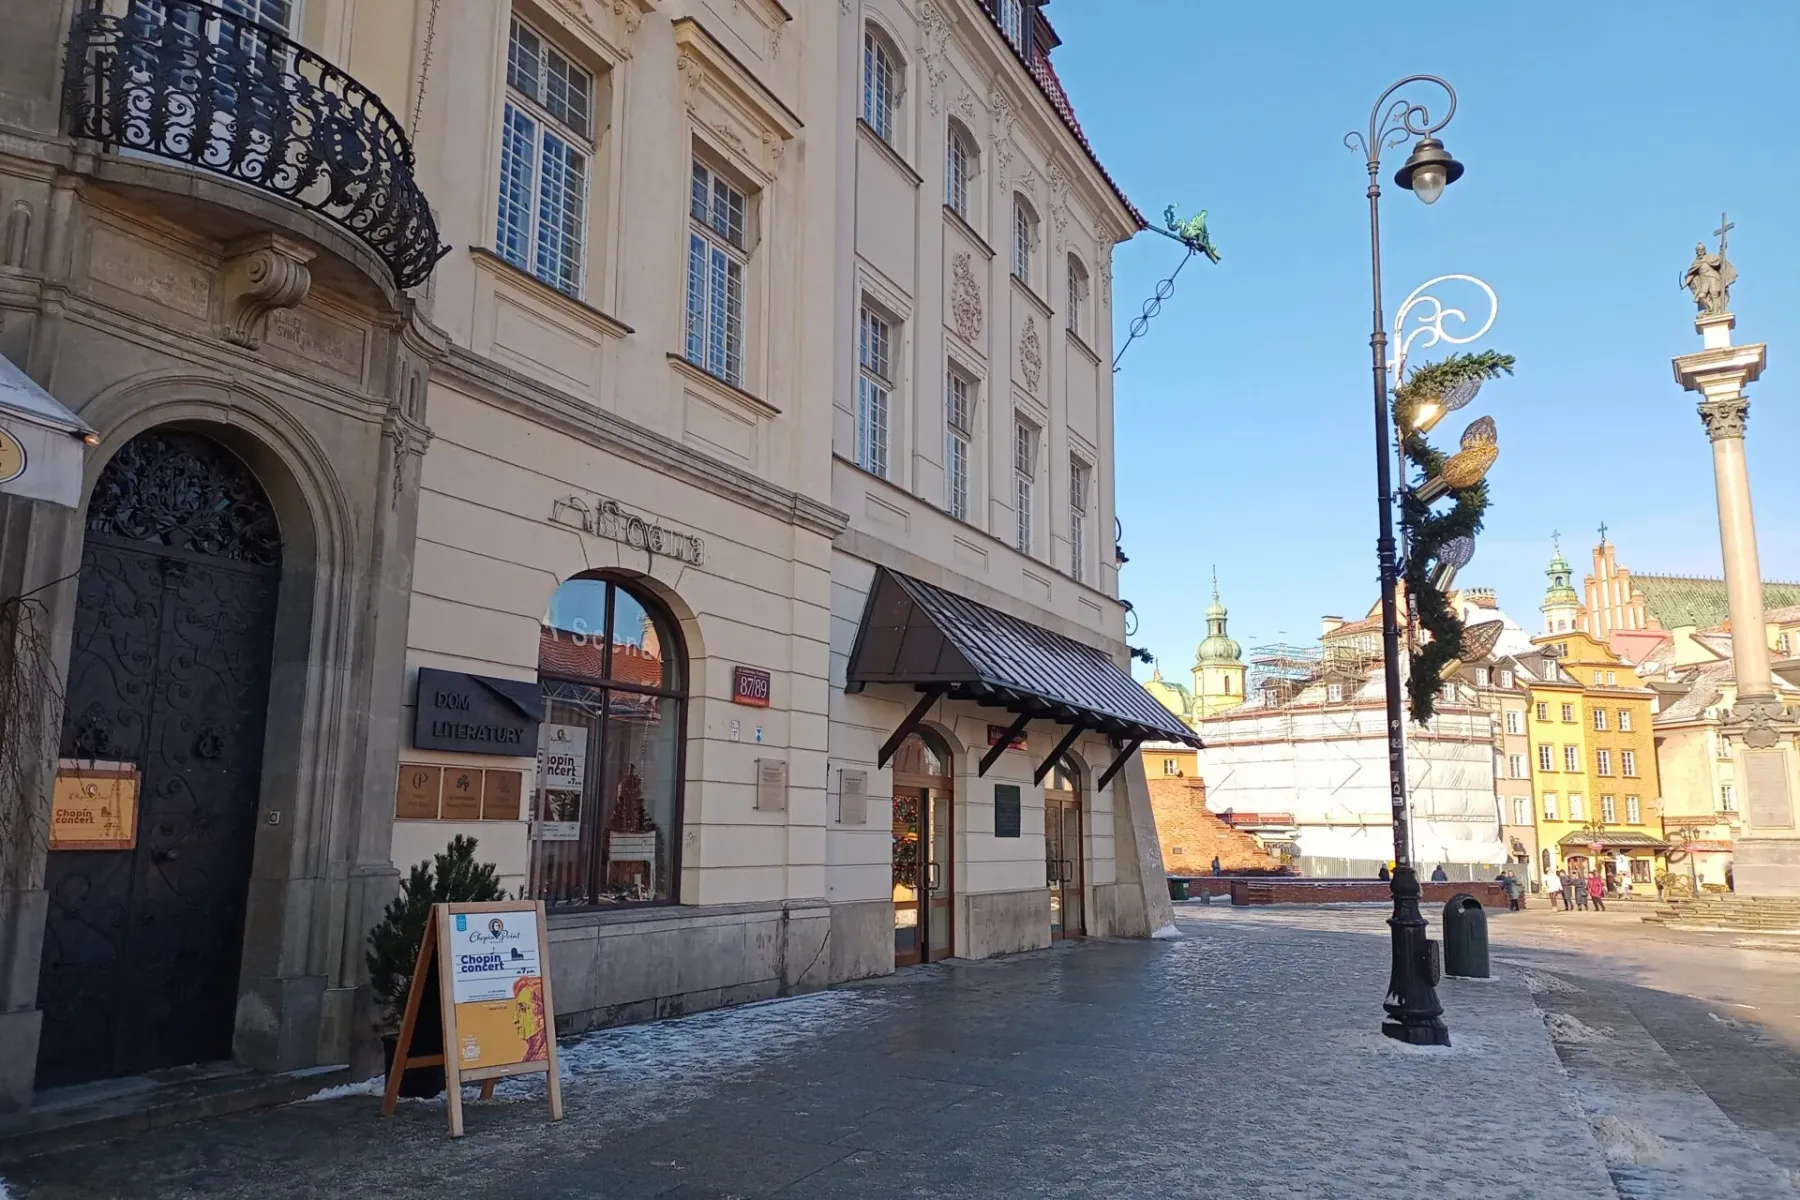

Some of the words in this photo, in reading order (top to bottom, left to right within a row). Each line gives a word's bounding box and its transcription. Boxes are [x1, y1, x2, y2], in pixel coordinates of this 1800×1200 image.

[740, 676, 767, 699] 87/89
[434, 691, 470, 710] DOM
[432, 720, 524, 744] LITERATURY
[536, 752, 575, 768] Copin
[55, 816, 94, 824] concert
[56, 809, 92, 820] Chopin
[461, 953, 502, 966] Chopin
[461, 961, 505, 973] concert
